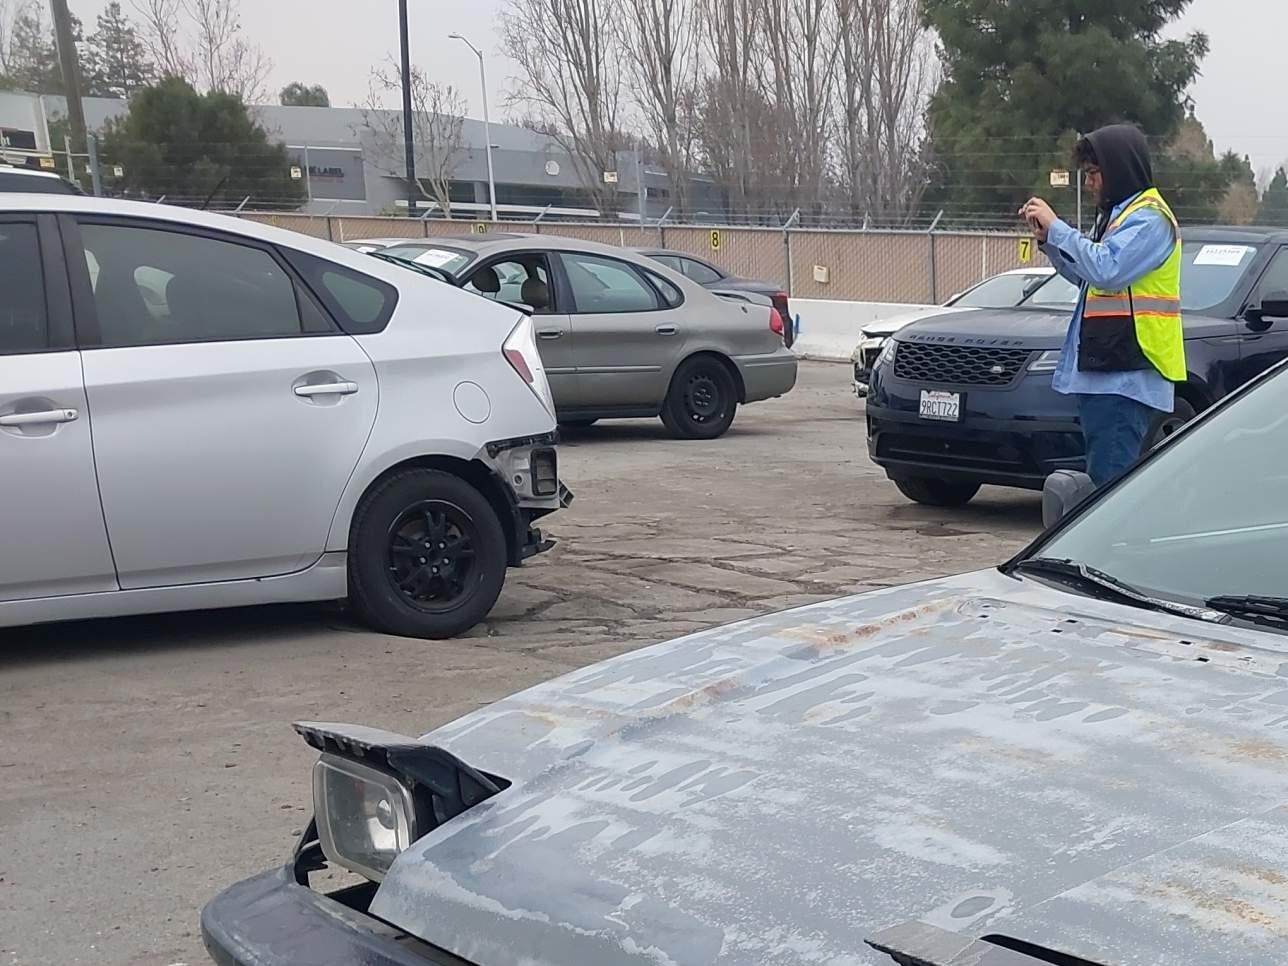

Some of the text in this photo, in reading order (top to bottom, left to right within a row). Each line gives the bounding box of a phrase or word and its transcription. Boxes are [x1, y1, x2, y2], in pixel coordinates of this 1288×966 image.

[711, 231, 719, 247] 8
[1020, 241, 1029, 258] 7
[921, 400, 958, 417] 9RCT722
